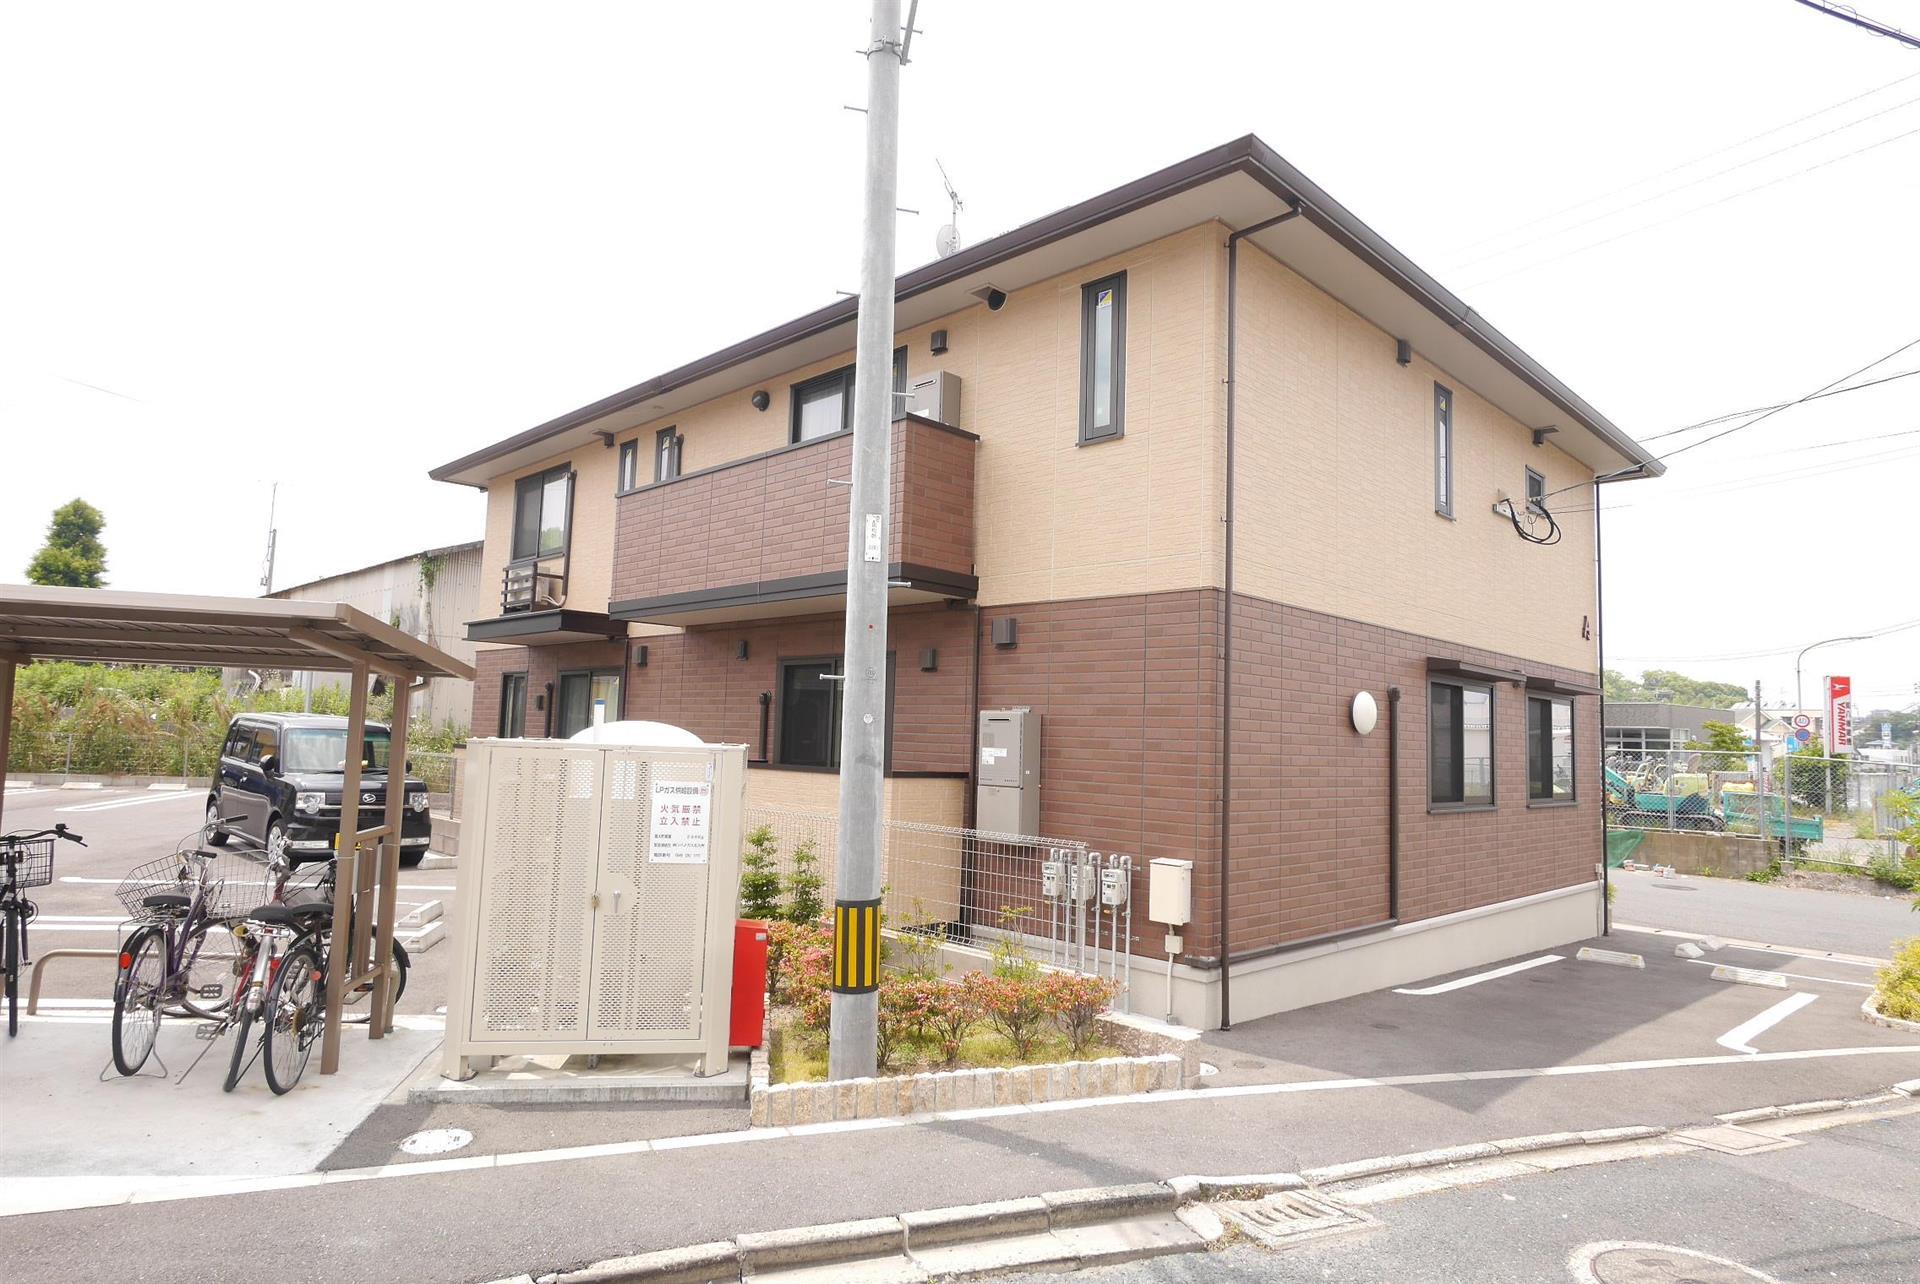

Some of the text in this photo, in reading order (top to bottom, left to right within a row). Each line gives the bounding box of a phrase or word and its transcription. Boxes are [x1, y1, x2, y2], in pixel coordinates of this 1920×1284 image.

[1837, 702, 1846, 746] YANMAR
[660, 804, 702, 814] 火気厳禁
[659, 816, 701, 826] 立入禁止
